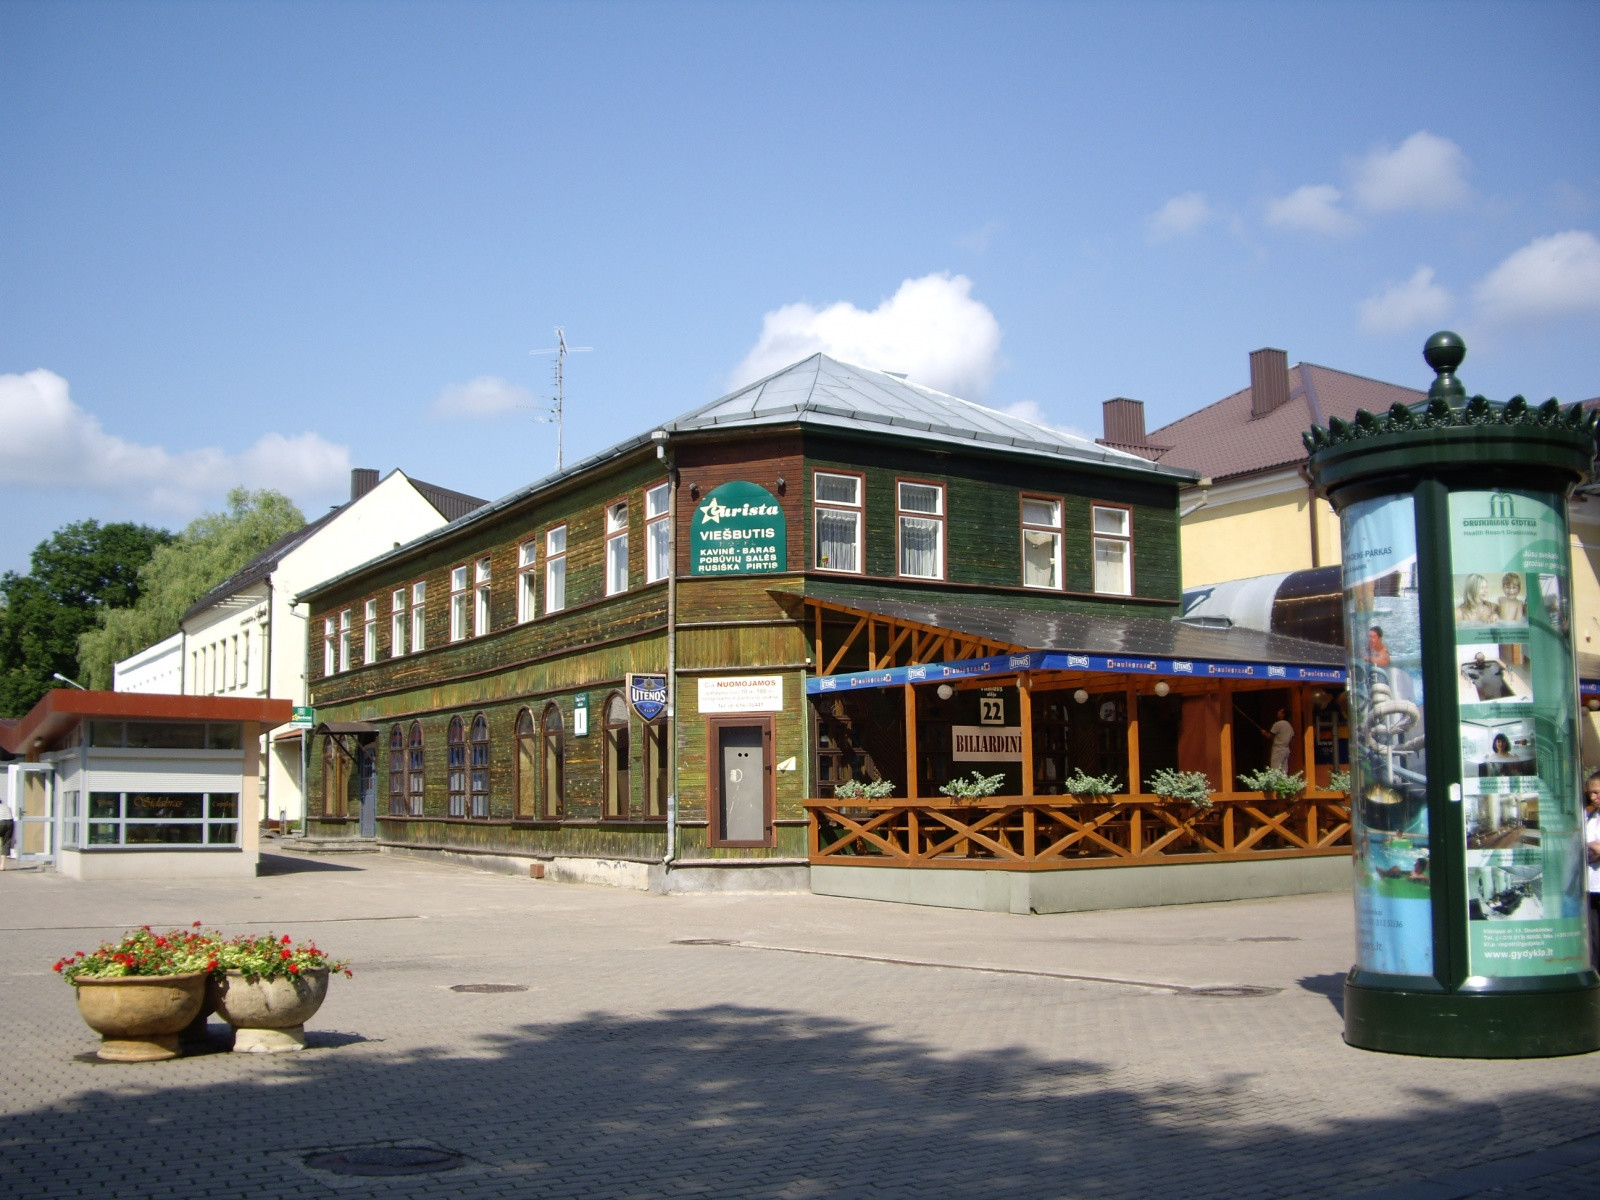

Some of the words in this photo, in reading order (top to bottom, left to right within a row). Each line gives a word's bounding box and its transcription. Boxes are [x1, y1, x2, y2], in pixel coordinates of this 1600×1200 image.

[699, 528, 775, 541] VIEŠBUTIS
[700, 547, 735, 556] KAVINĖ
[742, 546, 776, 554] BARAS
[1365, 547, 1392, 557] PARKAS
[699, 555, 741, 564] POBŪVIŲ
[745, 553, 777, 562] SALĖS
[698, 563, 740, 572] RUSIŠKA
[746, 562, 778, 570] PIRTIS
[1010, 656, 1030, 667] UTENOS
[1067, 654, 1089, 667] UTENOS
[1173, 660, 1193, 672] UTENOS
[716, 679, 776, 687] NUOMOJAMOS
[631, 688, 666, 703] UTENOS
[983, 702, 1002, 720] 22
[1484, 948, 1554, 960] www.gydykla.lt
